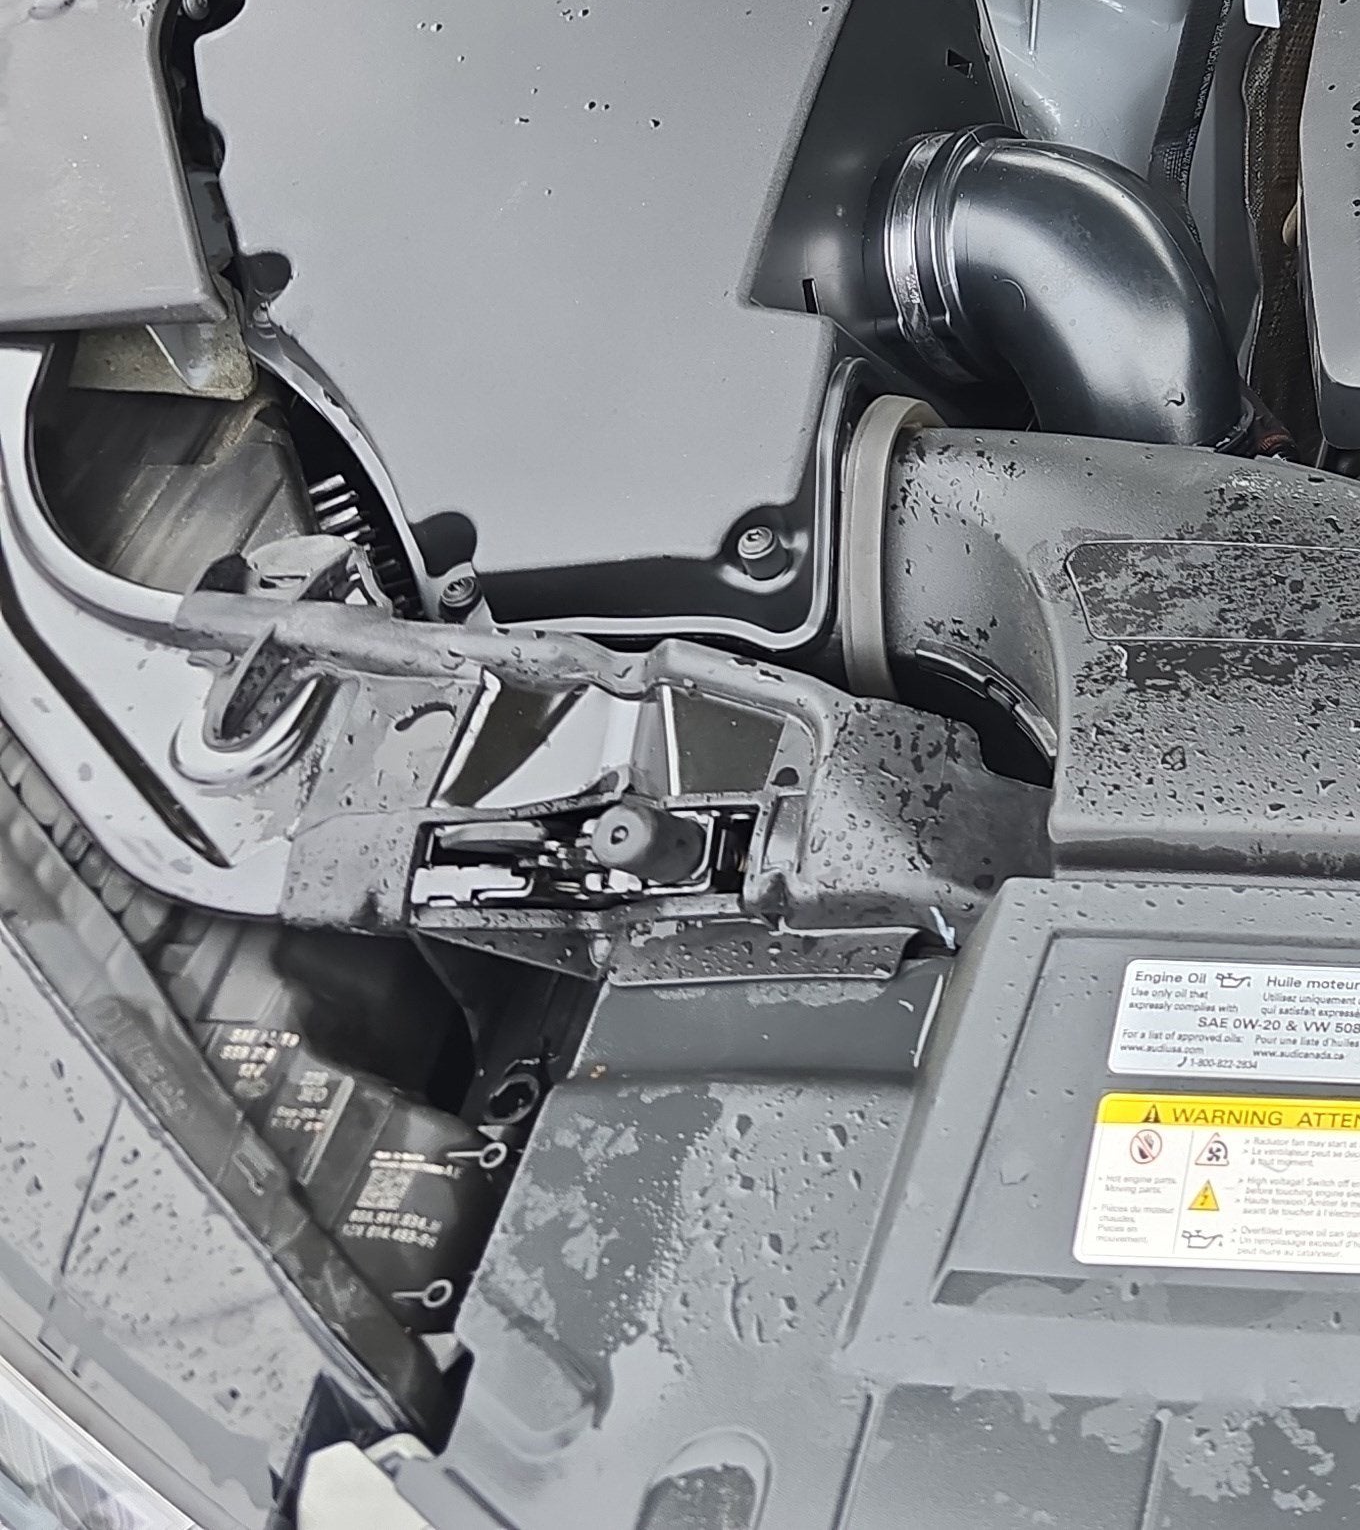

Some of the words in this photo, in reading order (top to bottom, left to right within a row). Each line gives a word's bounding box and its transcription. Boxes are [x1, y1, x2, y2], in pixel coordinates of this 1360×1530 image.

[1134, 971, 1184, 987] Engine
[1188, 972, 1206, 984] Oil
[1267, 976, 1301, 989] Huile
[1131, 988, 1149, 998] Use
[1152, 989, 1174, 1000] only
[1176, 989, 1187, 998] oil
[1190, 990, 1209, 999] that
[1263, 993, 1296, 1003] Utilisez
[1299, 994, 1355, 1007] uniquement
[1129, 1002, 1172, 1013] expressly
[1174, 1003, 1216, 1014] complies
[1218, 1004, 1238, 1013] with
[1261, 1006, 1276, 1016] qui
[1279, 1007, 1315, 1016] satisfait
[1198, 1017, 1228, 1029] SAE
[1232, 1019, 1281, 1031] 0W-20
[1287, 1021, 1297, 1032] &
[1303, 1021, 1330, 1033] VW
[1122, 1030, 1138, 1039] For
[1149, 1031, 1163, 1039] list
[1165, 1031, 1175, 1040] of
[1178, 1031, 1221, 1043] approved
[1255, 1035, 1277, 1045] Pour
[1301, 1037, 1320, 1046] liste
[1120, 1045, 1204, 1055] www.audiusa.com
[1253, 1050, 1344, 1060] www.audicanada.ca
[1172, 1107, 1283, 1127] WARNING
[1292, 1138, 1306, 1146] fan
[1307, 1140, 1325, 1148] may
[1328, 1140, 1347, 1148] start
[1311, 1150, 1331, 1159] peut
[1106, 1175, 1121, 1183] Hot
[1247, 1177, 1267, 1187] High
[1307, 1179, 1335, 1187] Switch
[1338, 1179, 1350, 1188] off
[1276, 1188, 1313, 1197] touching
[1315, 1190, 1344, 1199] engine
[1281, 1208, 1314, 1216] toucher
[1285, 1228, 1314, 1237] engine
